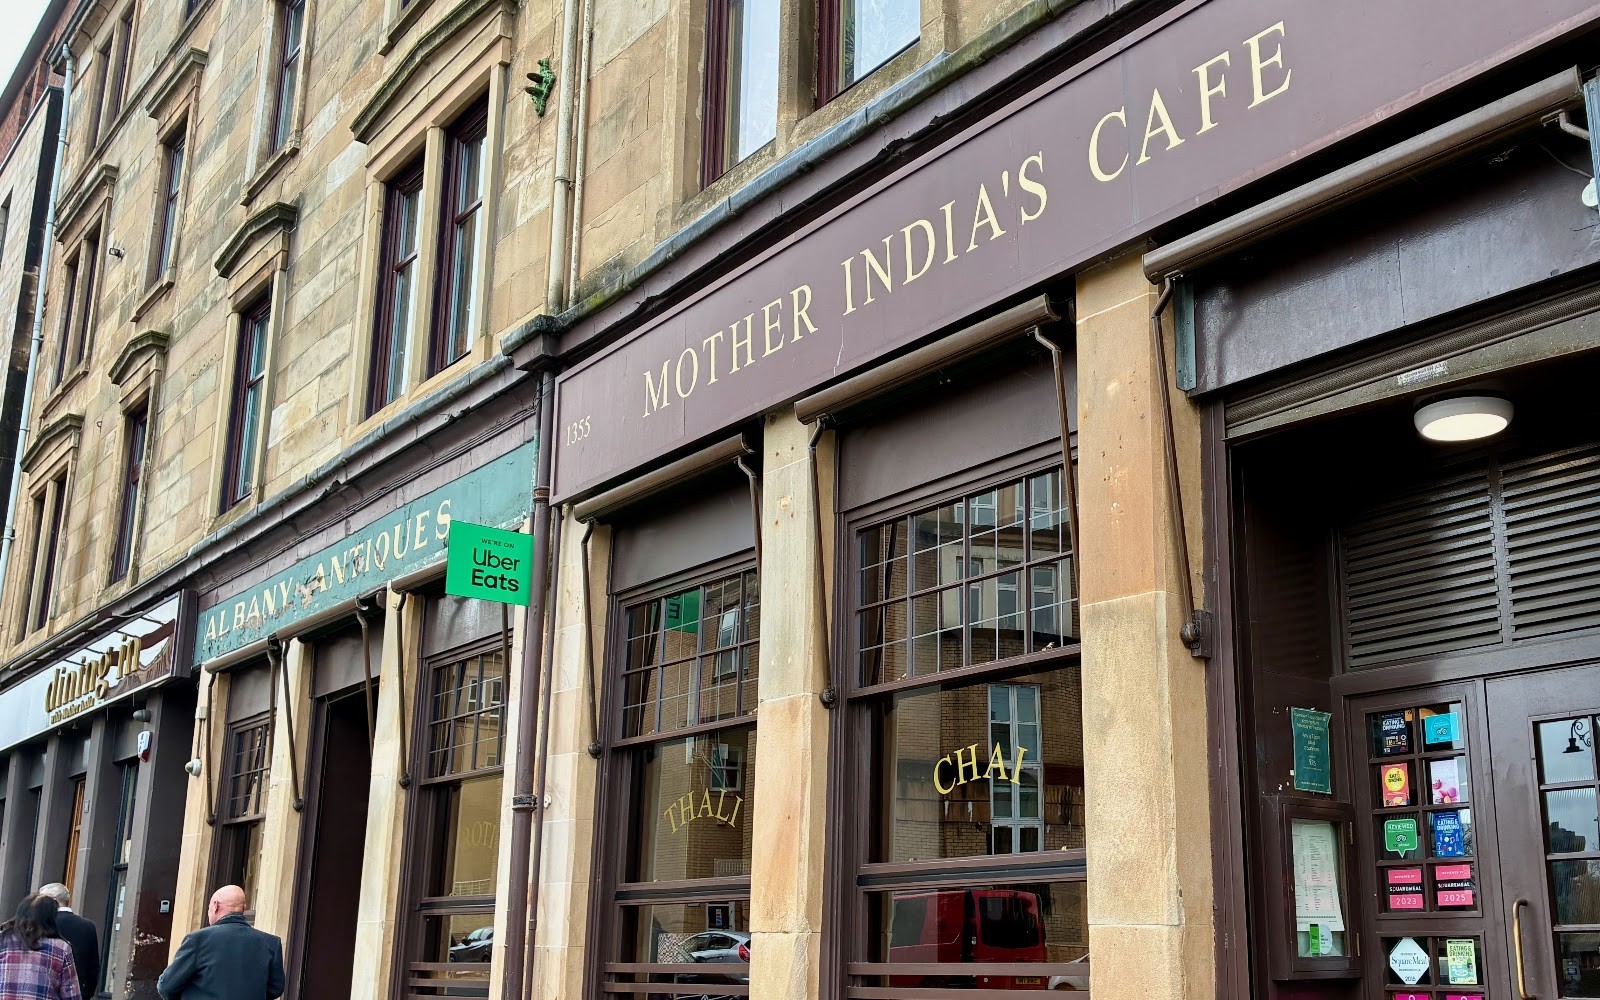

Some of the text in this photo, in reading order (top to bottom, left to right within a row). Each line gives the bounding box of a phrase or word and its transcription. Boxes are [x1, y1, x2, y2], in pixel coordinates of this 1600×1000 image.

[642, 20, 1292, 418] MOTHER INDIA'S CAFE
[566, 414, 592, 448] 1355
[481, 538, 502, 547] WE'RE
[204, 499, 452, 644] ALBANY ANTIQUES
[473, 547, 520, 571] Uber
[472, 567, 519, 593] Eats
[45, 634, 141, 713] dining in
[933, 742, 1028, 795] CHAI
[664, 787, 744, 834] THALI
[462, 821, 497, 849] ROTI
[1396, 897, 1417, 905] 2023
[1444, 893, 1466, 902] 2025
